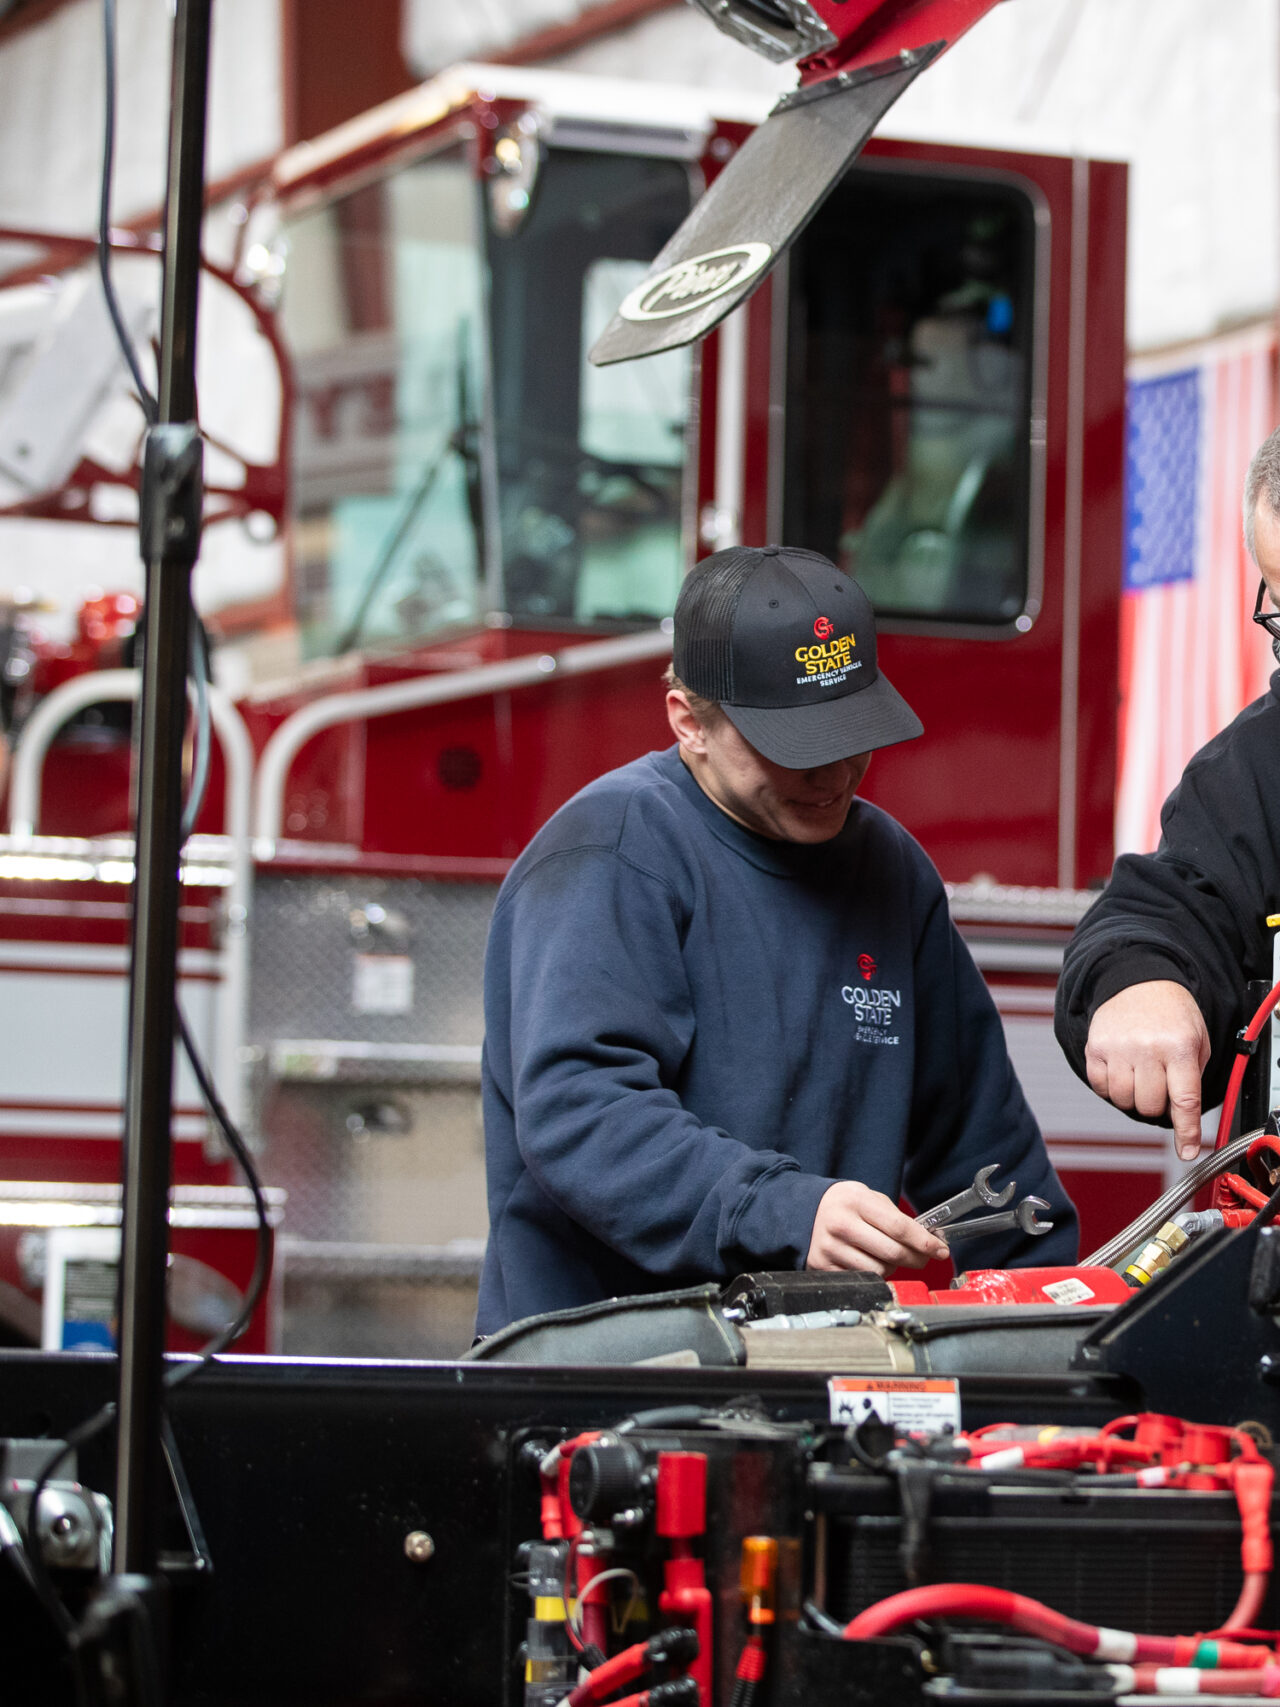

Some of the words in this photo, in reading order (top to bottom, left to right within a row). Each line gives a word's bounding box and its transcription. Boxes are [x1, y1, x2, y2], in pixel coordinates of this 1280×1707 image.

[795, 633, 856, 662] GOLDEN
[805, 651, 851, 675] STATE
[796, 671, 839, 684] EMERGENCY
[820, 674, 846, 687] SERVICE
[841, 986, 901, 1007] GOLDEN
[854, 1003, 892, 1025] STATE
